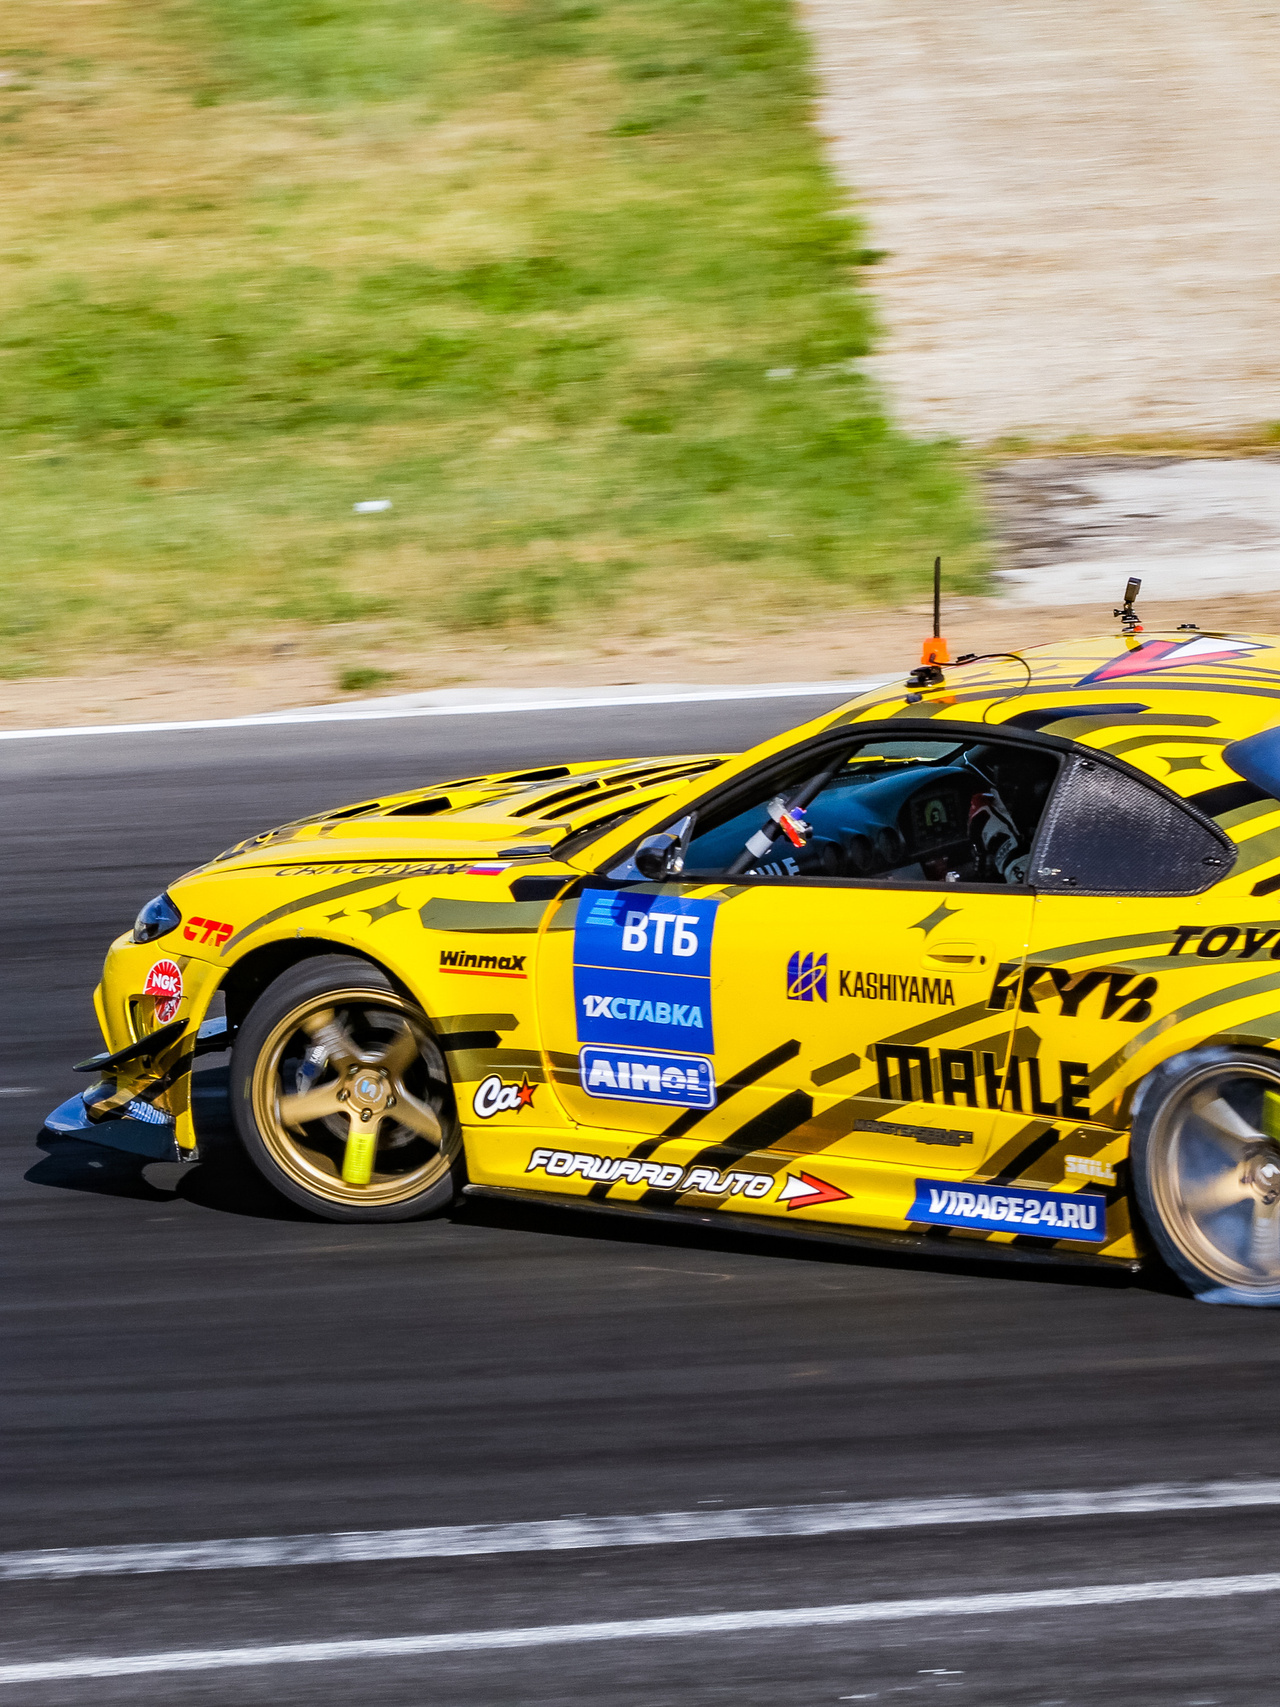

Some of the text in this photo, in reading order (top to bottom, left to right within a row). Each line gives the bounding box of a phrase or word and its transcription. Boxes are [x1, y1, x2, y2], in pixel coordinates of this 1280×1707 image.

[621, 910, 700, 957] ВТБ
[151, 973, 179, 993] NGK
[839, 970, 955, 1006] KASHIYAMA
[985, 962, 1159, 1023] KYB
[875, 1043, 1091, 1120] MAHLE
[527, 1149, 775, 1199] FORWARD AUTO
[929, 1188, 1097, 1231] VIRAGE24.RU
